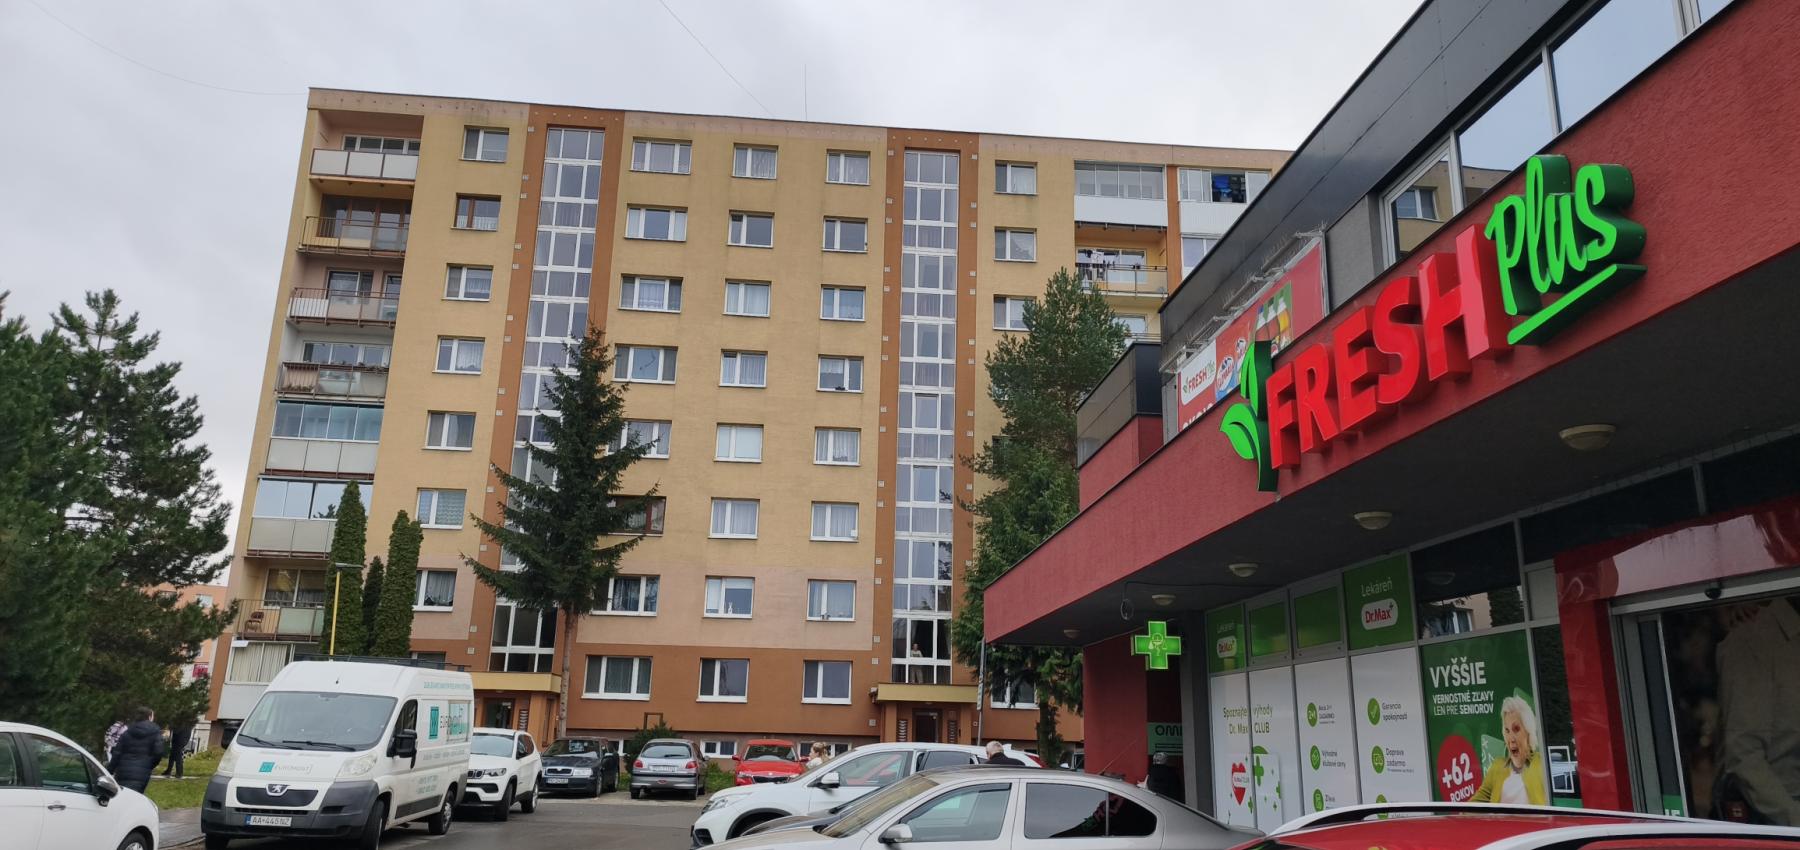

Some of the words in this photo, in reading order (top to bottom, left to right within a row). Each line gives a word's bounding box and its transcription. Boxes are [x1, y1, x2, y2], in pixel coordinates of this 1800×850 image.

[1267, 224, 1492, 470] FRESH
[1484, 155, 1622, 316] Plus
[1188, 367, 1207, 392] FRESH
[1361, 577, 1393, 597] Lekáreň
[1429, 656, 1487, 688] VYŠŠIE
[1432, 690, 1471, 704] VERNOSTNÉ
[1472, 690, 1494, 702] ZĽAVY
[1434, 705, 1446, 716] LEN
[1446, 704, 1459, 715] PRE
[1459, 703, 1494, 714] SENIOROV
[1254, 721, 1270, 734] CLUB
[1442, 752, 1474, 789] +62
[1450, 784, 1475, 802] ROKOV
